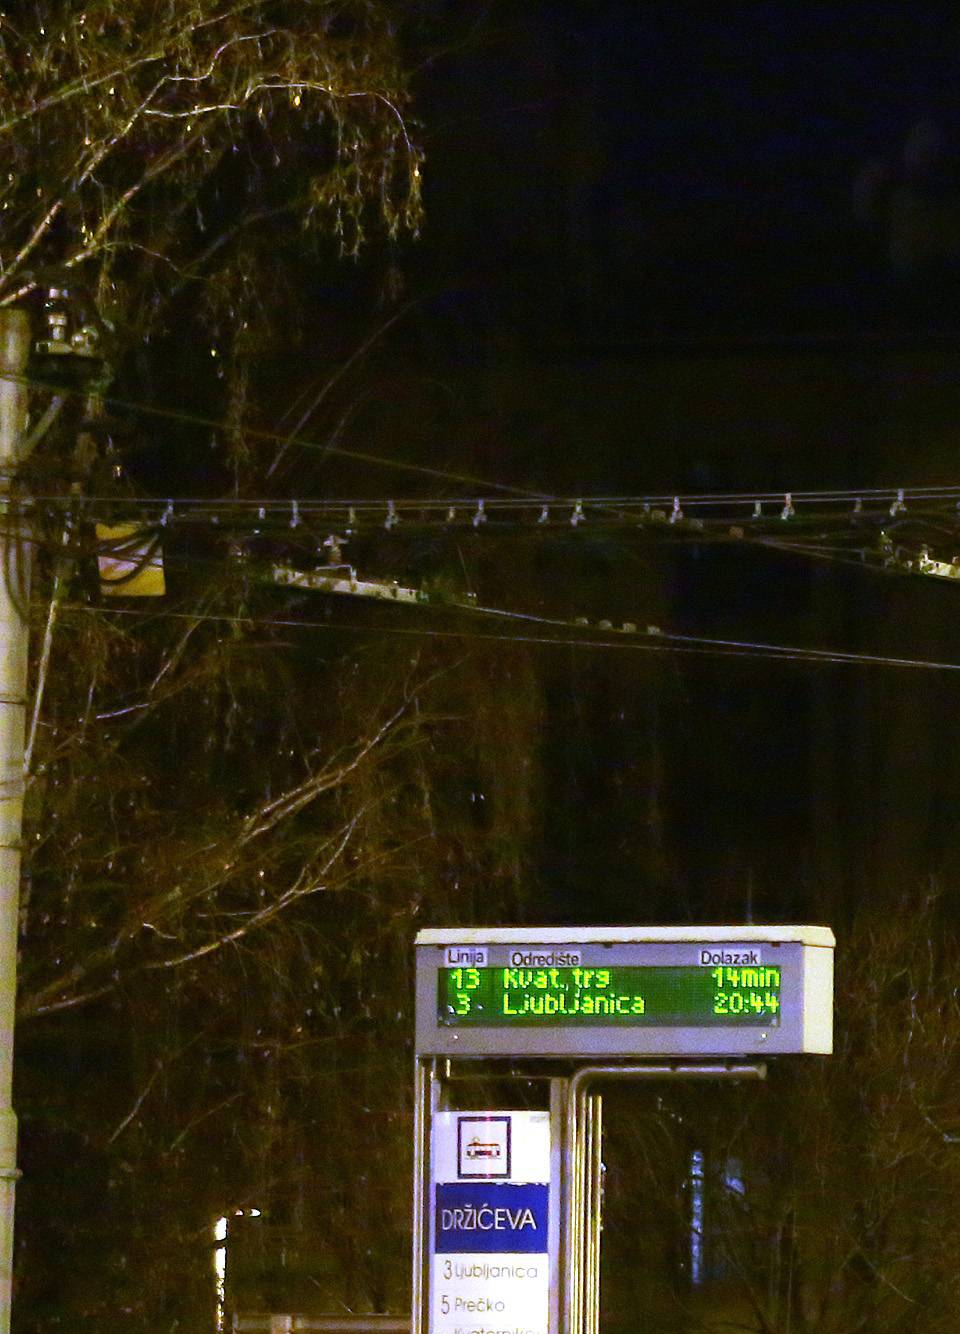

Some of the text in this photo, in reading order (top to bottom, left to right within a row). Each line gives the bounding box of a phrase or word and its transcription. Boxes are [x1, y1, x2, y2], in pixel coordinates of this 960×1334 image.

[448, 951, 484, 965] Linija
[701, 951, 758, 964] Dolazak
[451, 968, 481, 989] 13
[572, 968, 611, 989] trg
[712, 967, 780, 987] 14min
[456, 993, 779, 1015] 3 Ljubljanica 20:44
[442, 1203, 537, 1231] DRŽIĆEVA
[443, 1260, 538, 1280] 3 Ljubljanica
[440, 1295, 505, 1315] 5 Prečko
